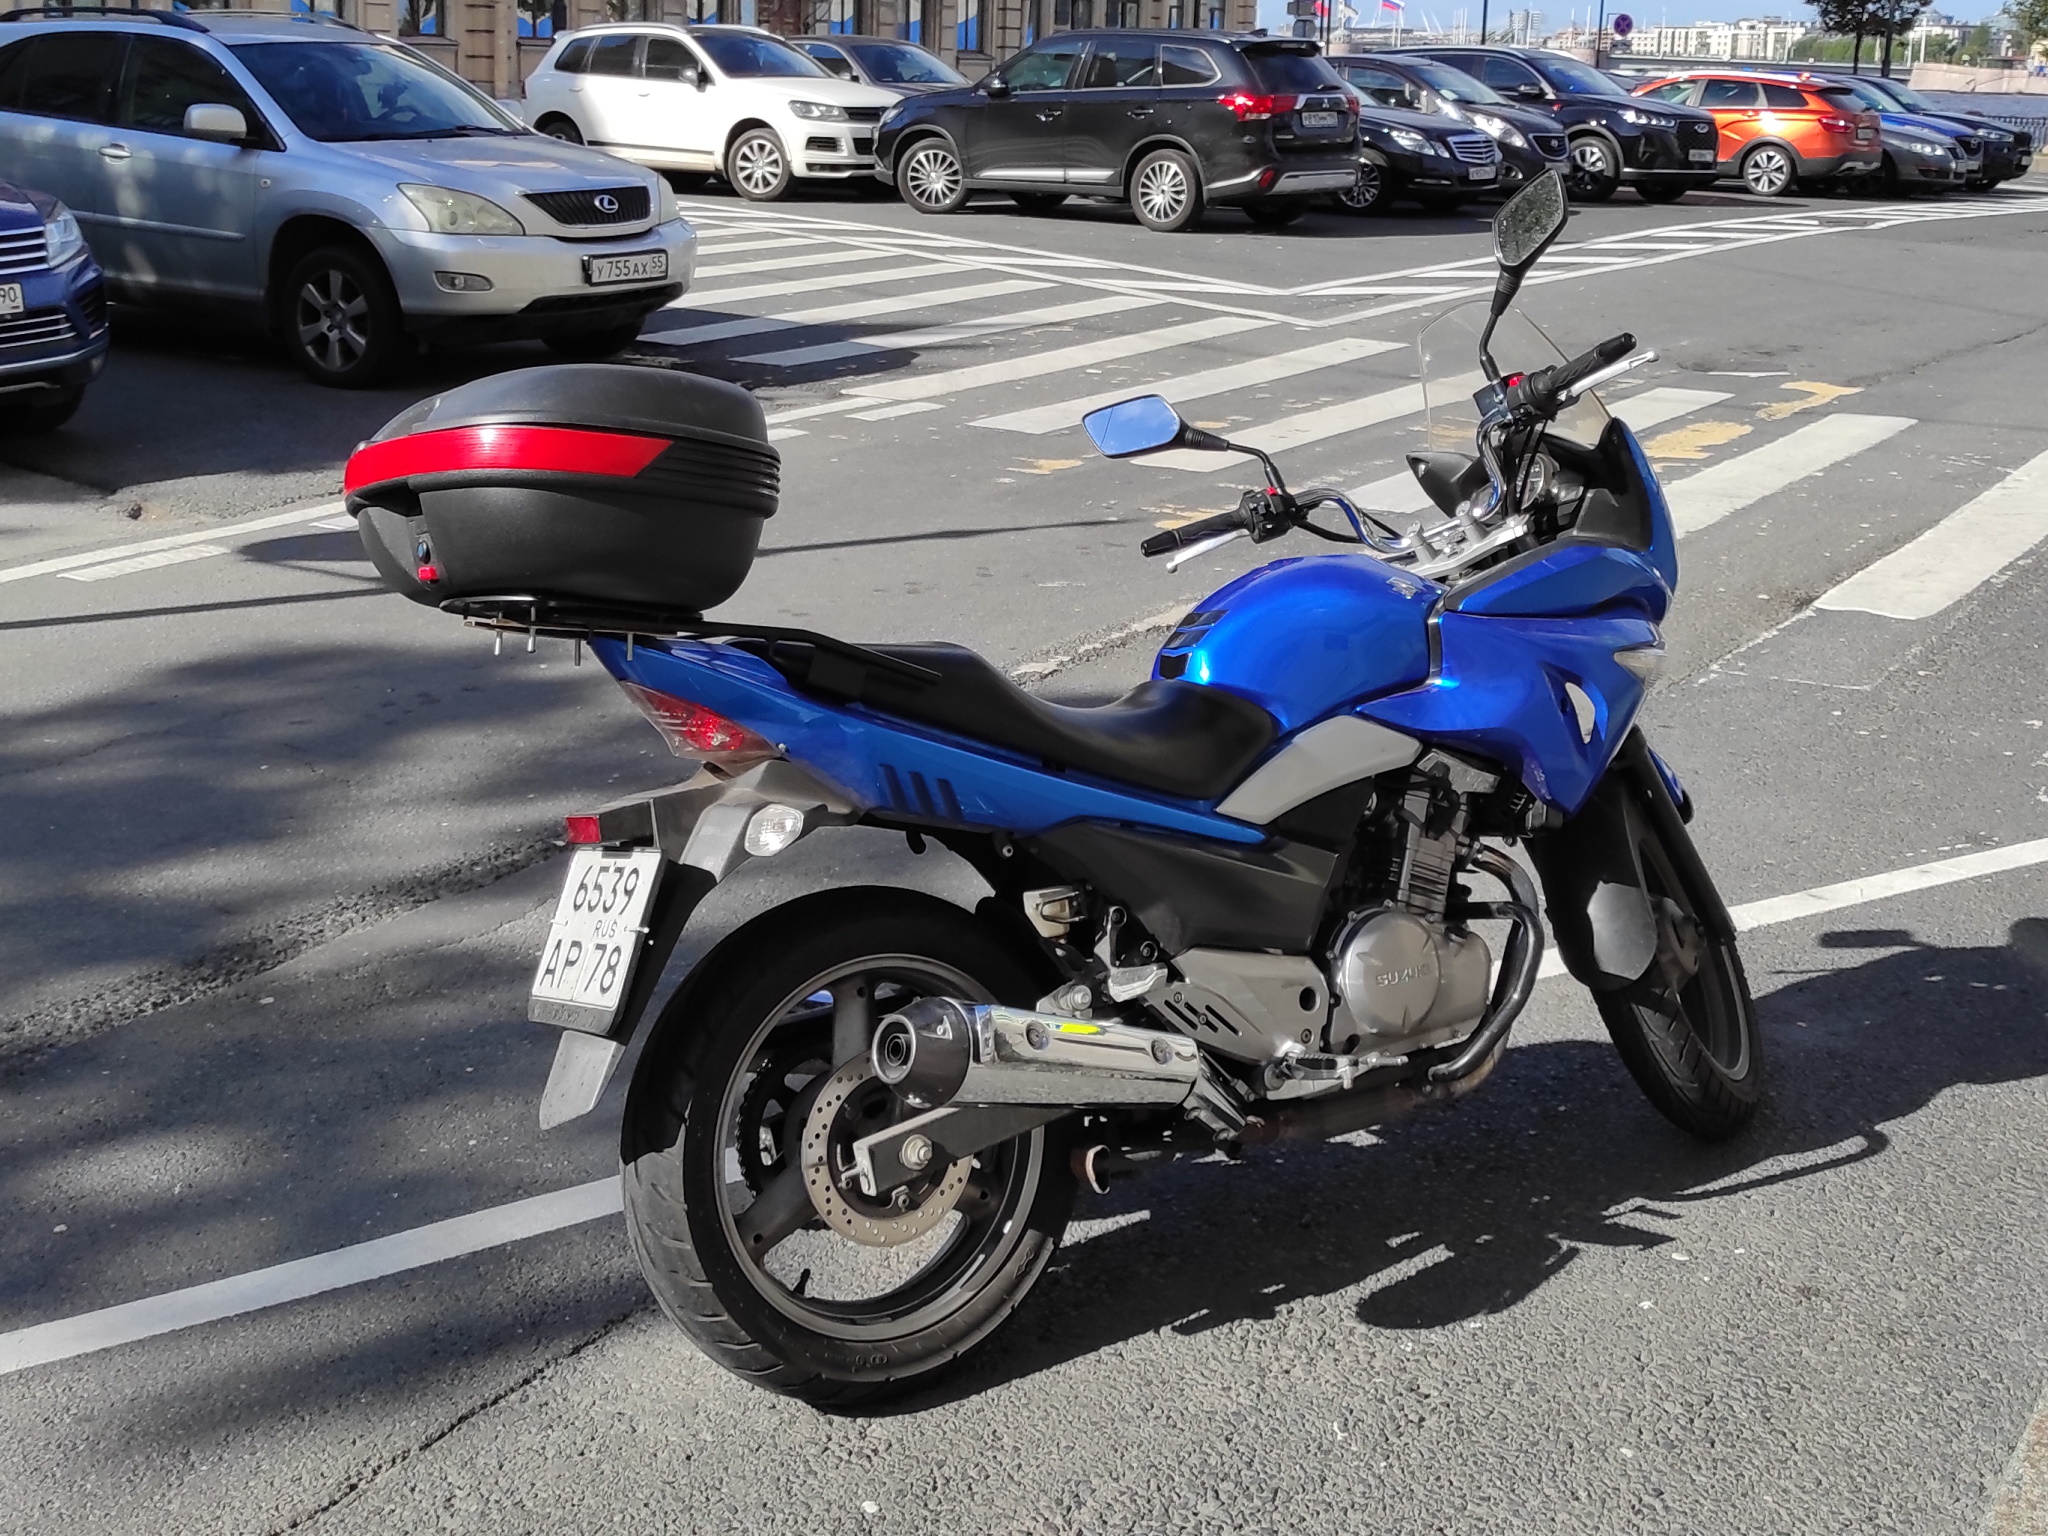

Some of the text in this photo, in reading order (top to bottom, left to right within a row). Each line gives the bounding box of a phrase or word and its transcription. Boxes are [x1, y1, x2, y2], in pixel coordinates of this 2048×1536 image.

[651, 255, 663, 270] 55
[573, 864, 640, 916] 6539
[592, 919, 618, 939] RUS
[583, 943, 622, 995] 78
